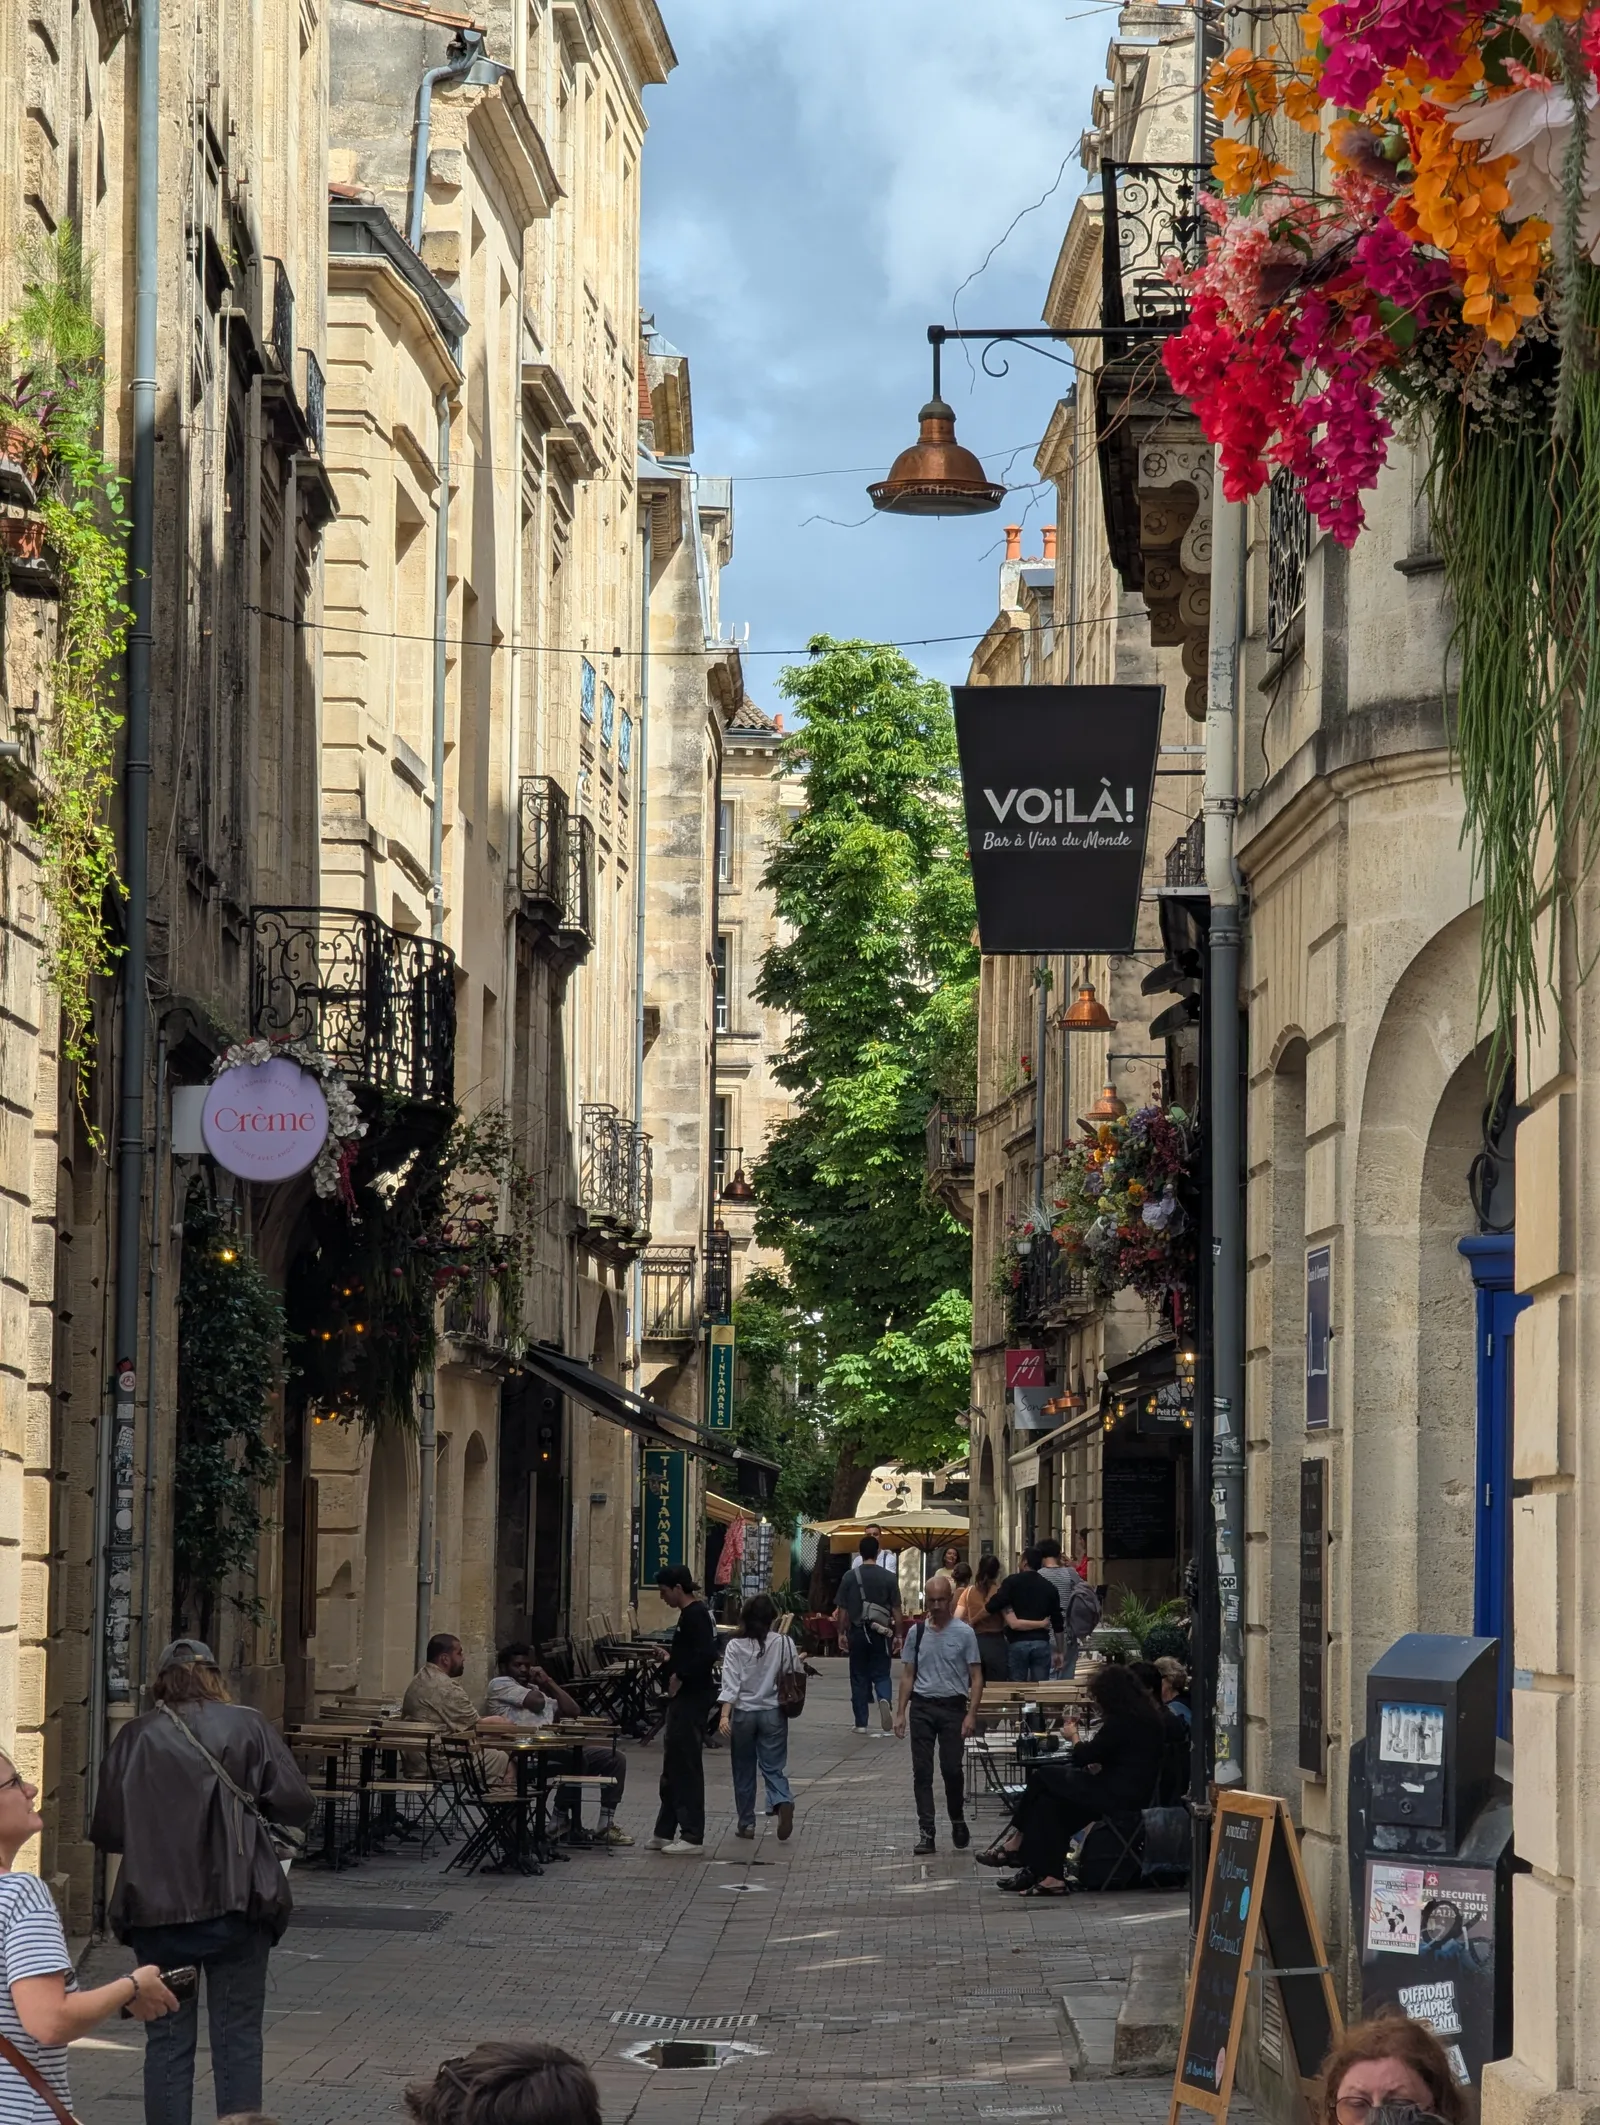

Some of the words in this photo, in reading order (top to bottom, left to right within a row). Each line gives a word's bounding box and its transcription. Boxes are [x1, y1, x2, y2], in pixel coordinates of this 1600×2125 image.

[983, 831, 1012, 850] Bar
[1014, 834, 1026, 846] à
[1029, 831, 1057, 849] Vins
[1062, 831, 1082, 846] du
[1083, 831, 1132, 849] Monde
[214, 1106, 316, 1132] Crème
[717, 1347, 726, 1425] TINTAMARRE
[1156, 1408, 1171, 1416] Petit
[657, 1455, 671, 1567] TINTAMARR
[1464, 1902, 1489, 1912] SOUS
[1391, 1932, 1401, 1941] LA
[1401, 1933, 1416, 1942] RUE
[1400, 1982, 1453, 2004] DIFFIDATI
[1407, 1998, 1452, 2018] SEMPRE
